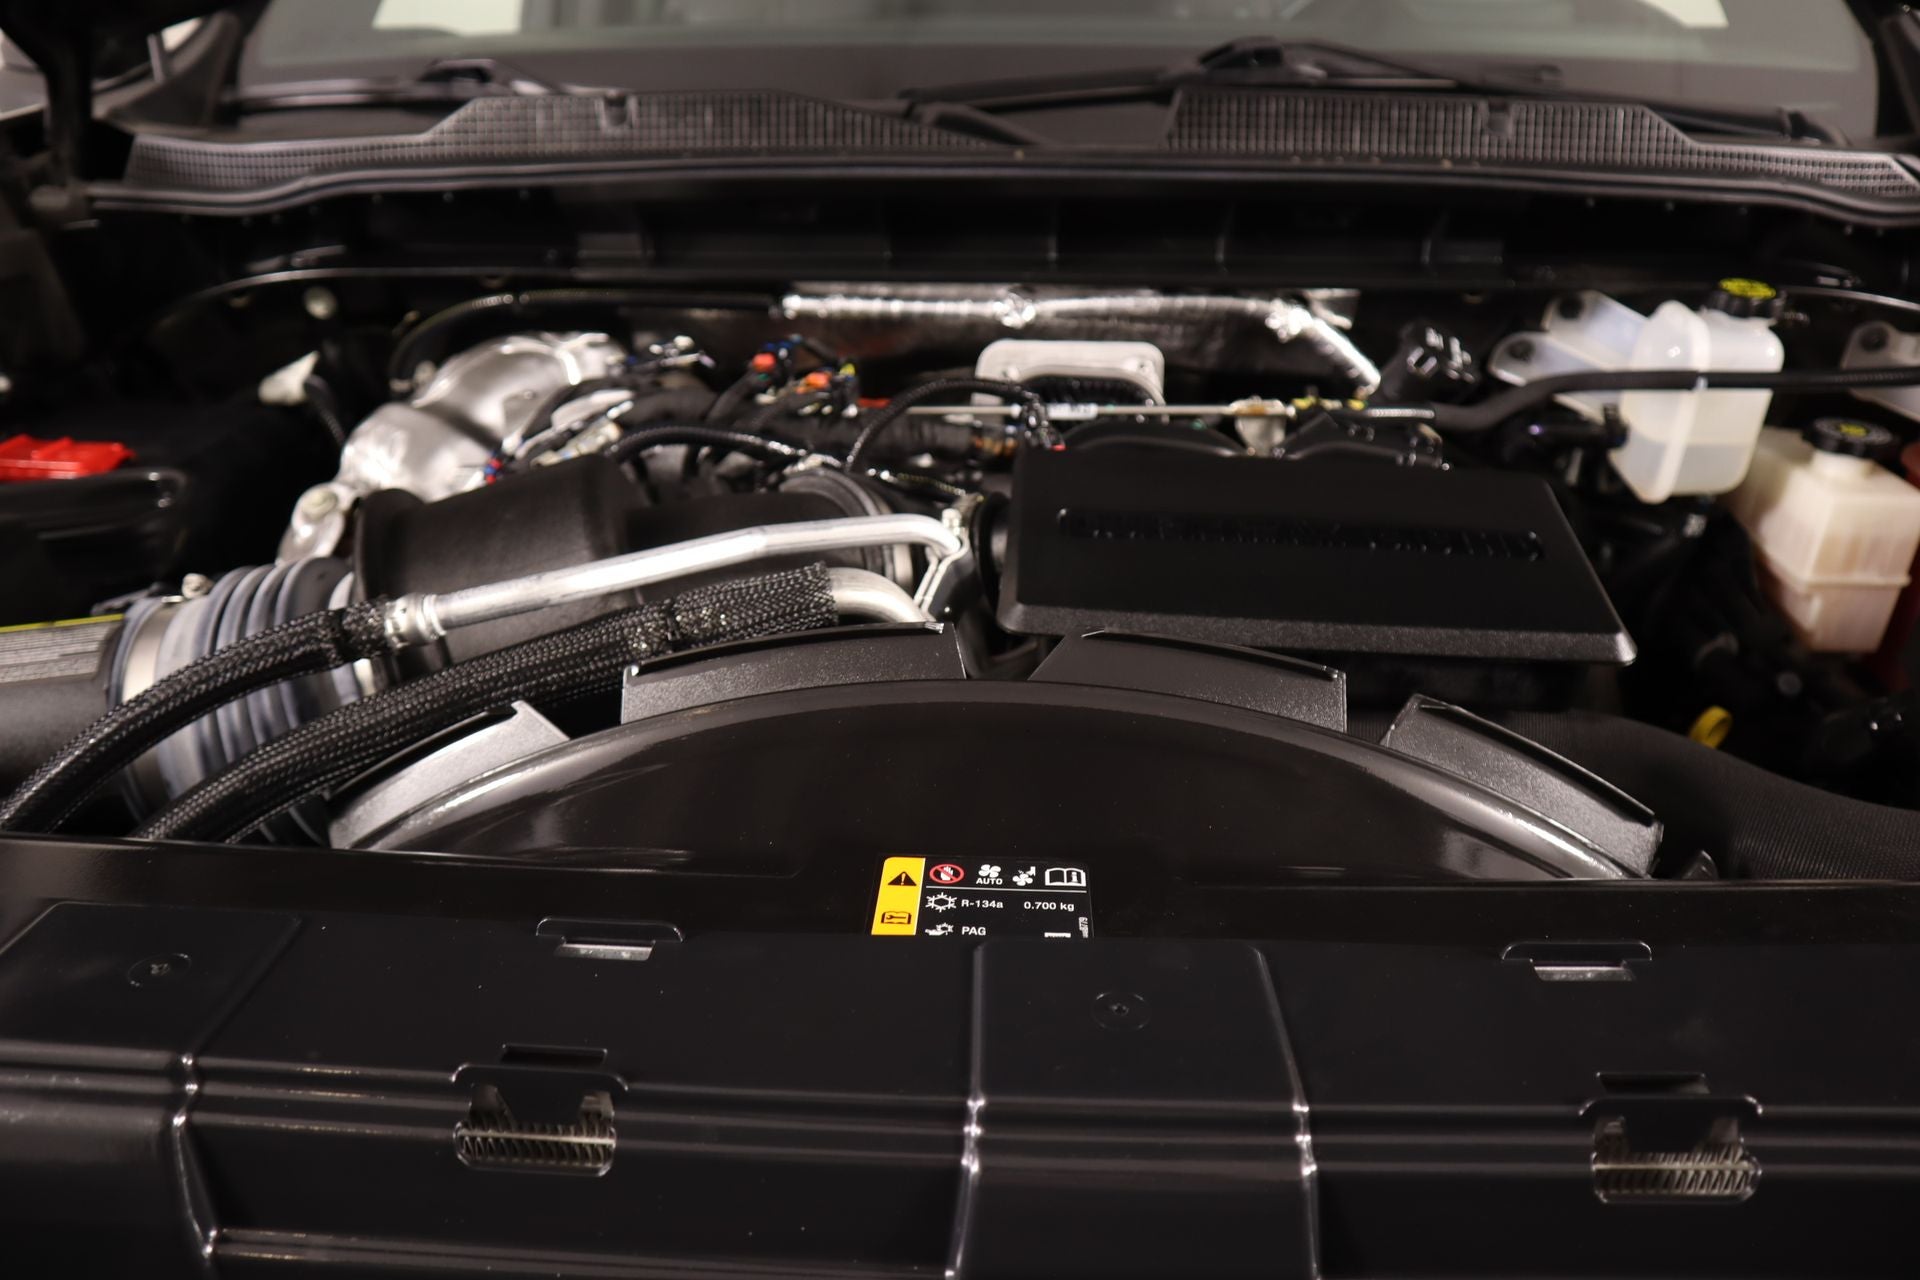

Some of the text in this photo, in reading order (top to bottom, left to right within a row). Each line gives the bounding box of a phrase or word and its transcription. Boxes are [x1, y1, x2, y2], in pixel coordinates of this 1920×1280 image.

[975, 877, 1003, 886] AUTO
[961, 899, 1075, 913] R-134a 0.700 kg
[961, 926, 987, 936] PAG
